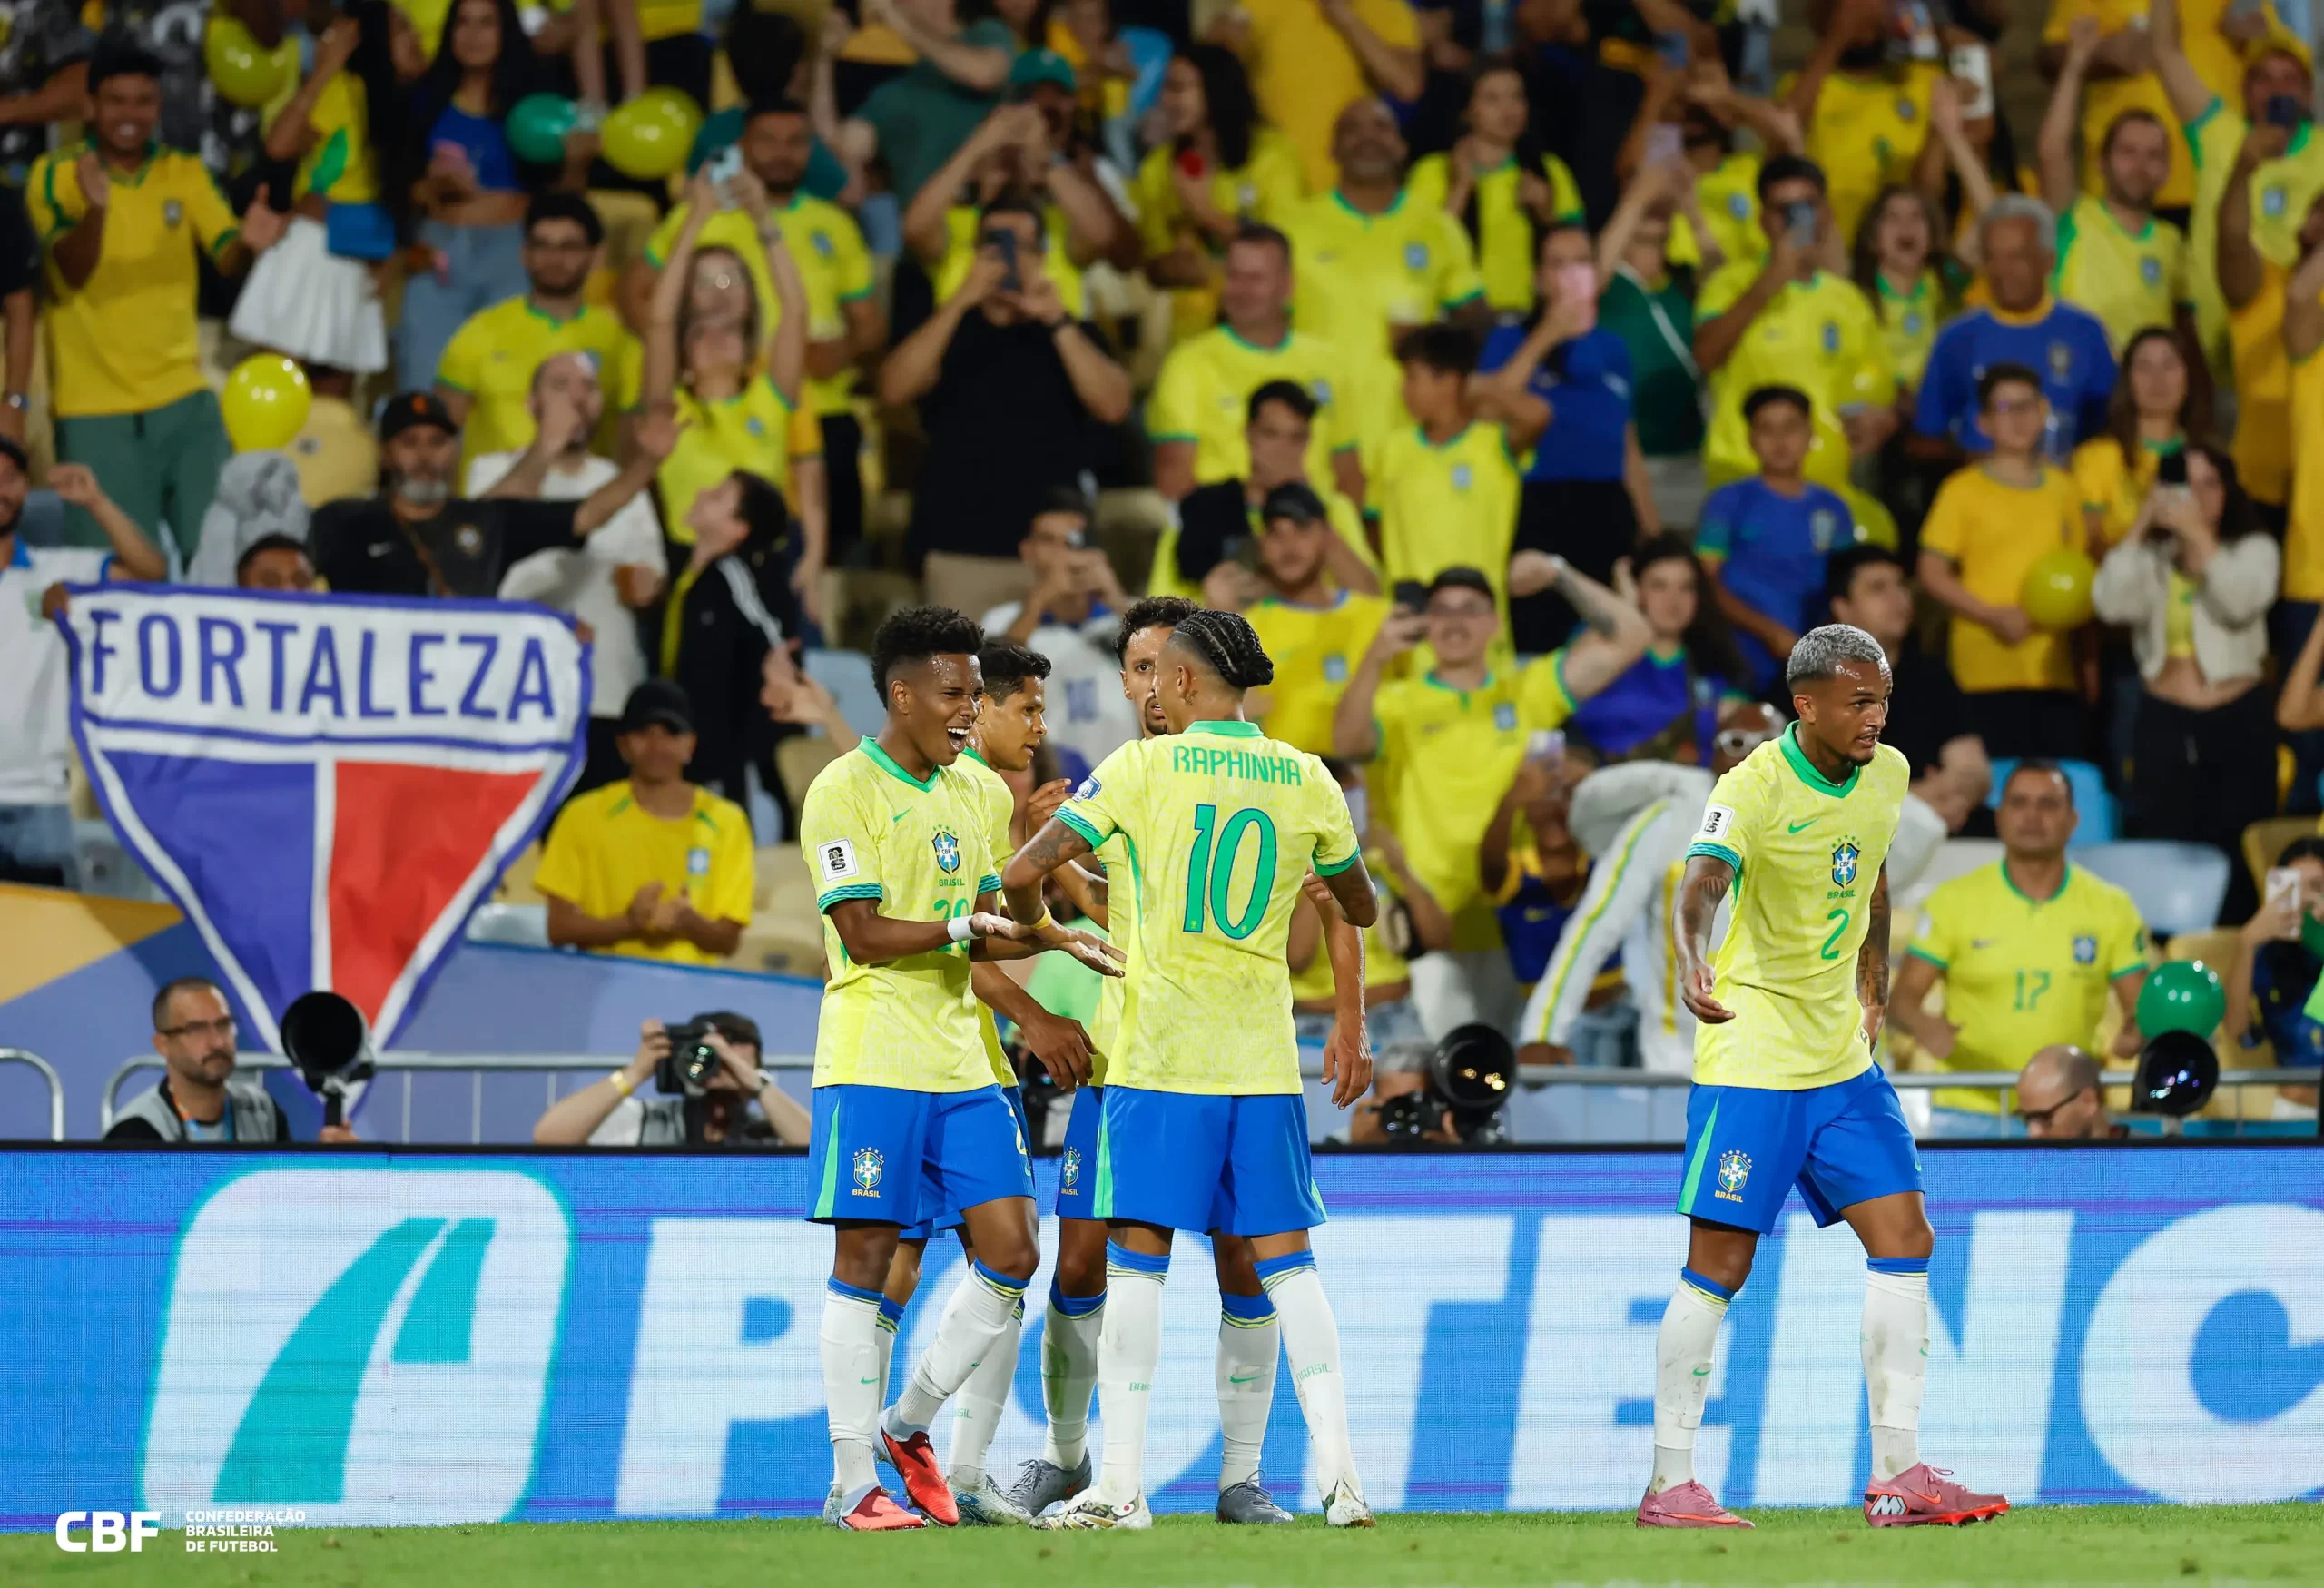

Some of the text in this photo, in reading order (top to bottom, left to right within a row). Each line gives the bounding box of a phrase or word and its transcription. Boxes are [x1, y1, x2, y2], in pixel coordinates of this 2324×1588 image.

[89, 609, 556, 723] FORTALEZA
[1172, 745, 1303, 787] RAPHINHA
[939, 878, 966, 887] BRASIL
[1183, 804, 1277, 940] 10
[1827, 889, 1856, 900] BRASIL
[1820, 908, 1850, 960] 2
[2014, 969, 2052, 1011] 17
[852, 1188, 881, 1198] BRASIL
[1714, 1189, 1744, 1203] BRASIL
